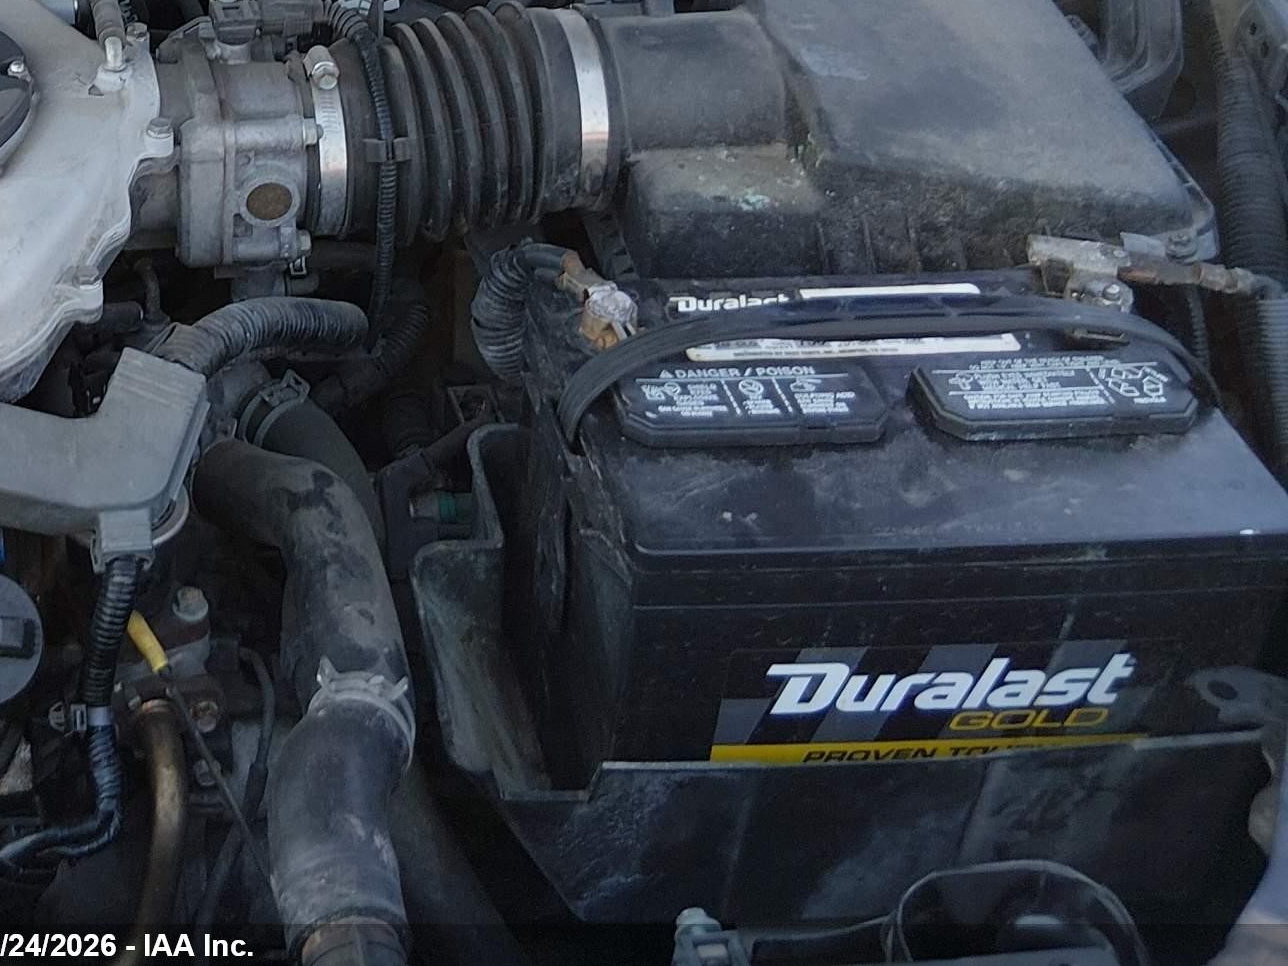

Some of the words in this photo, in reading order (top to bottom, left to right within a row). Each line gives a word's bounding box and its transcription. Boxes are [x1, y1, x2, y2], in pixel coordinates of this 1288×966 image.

[675, 368, 741, 379] DANGER
[755, 365, 816, 376] POISON
[767, 653, 1135, 714] Duralast
[949, 707, 1109, 731] GOLD
[803, 747, 938, 763] PROVEN
